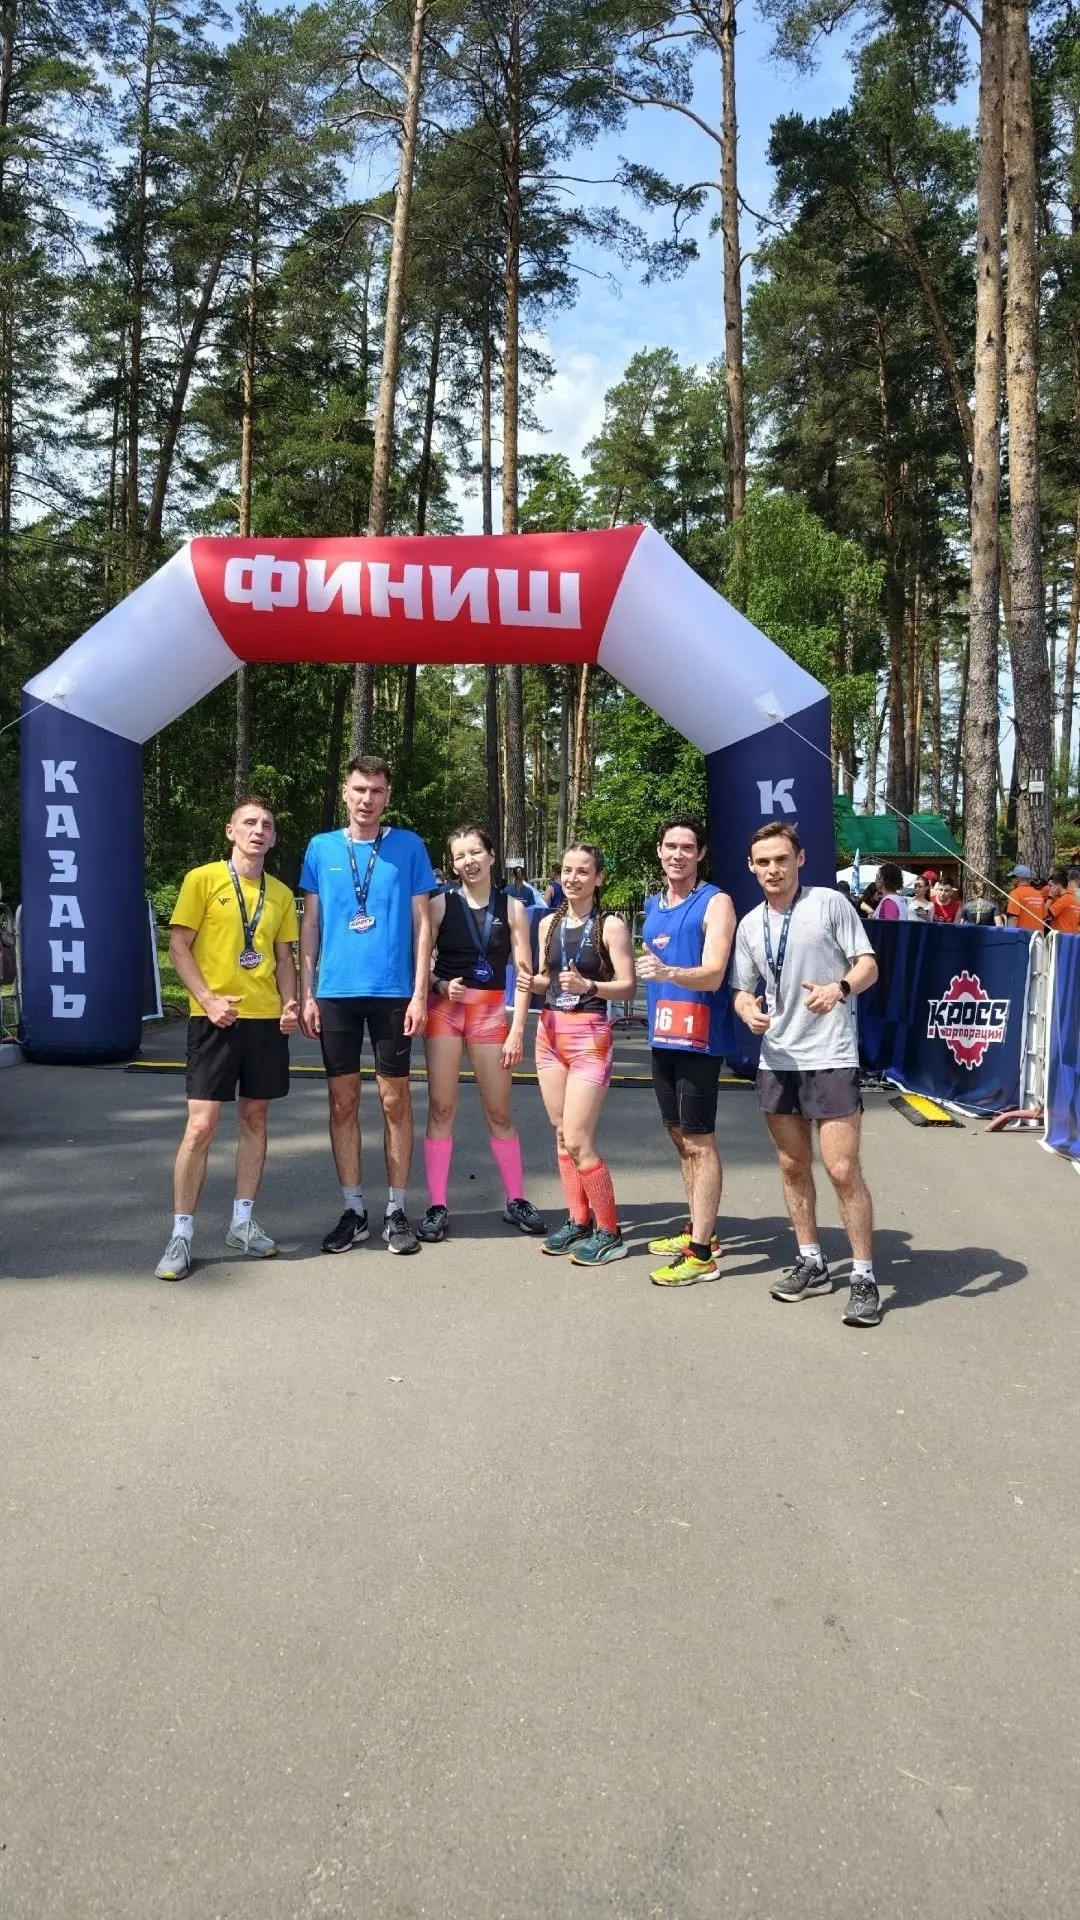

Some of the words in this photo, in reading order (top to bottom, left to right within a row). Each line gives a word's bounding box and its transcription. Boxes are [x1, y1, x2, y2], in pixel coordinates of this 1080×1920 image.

[224, 555, 581, 630] ФИНИШ
[41, 760, 86, 1019] КАЗАНЬ
[684, 1015, 694, 1034] 1
[928, 1001, 1008, 1027] КРОСС
